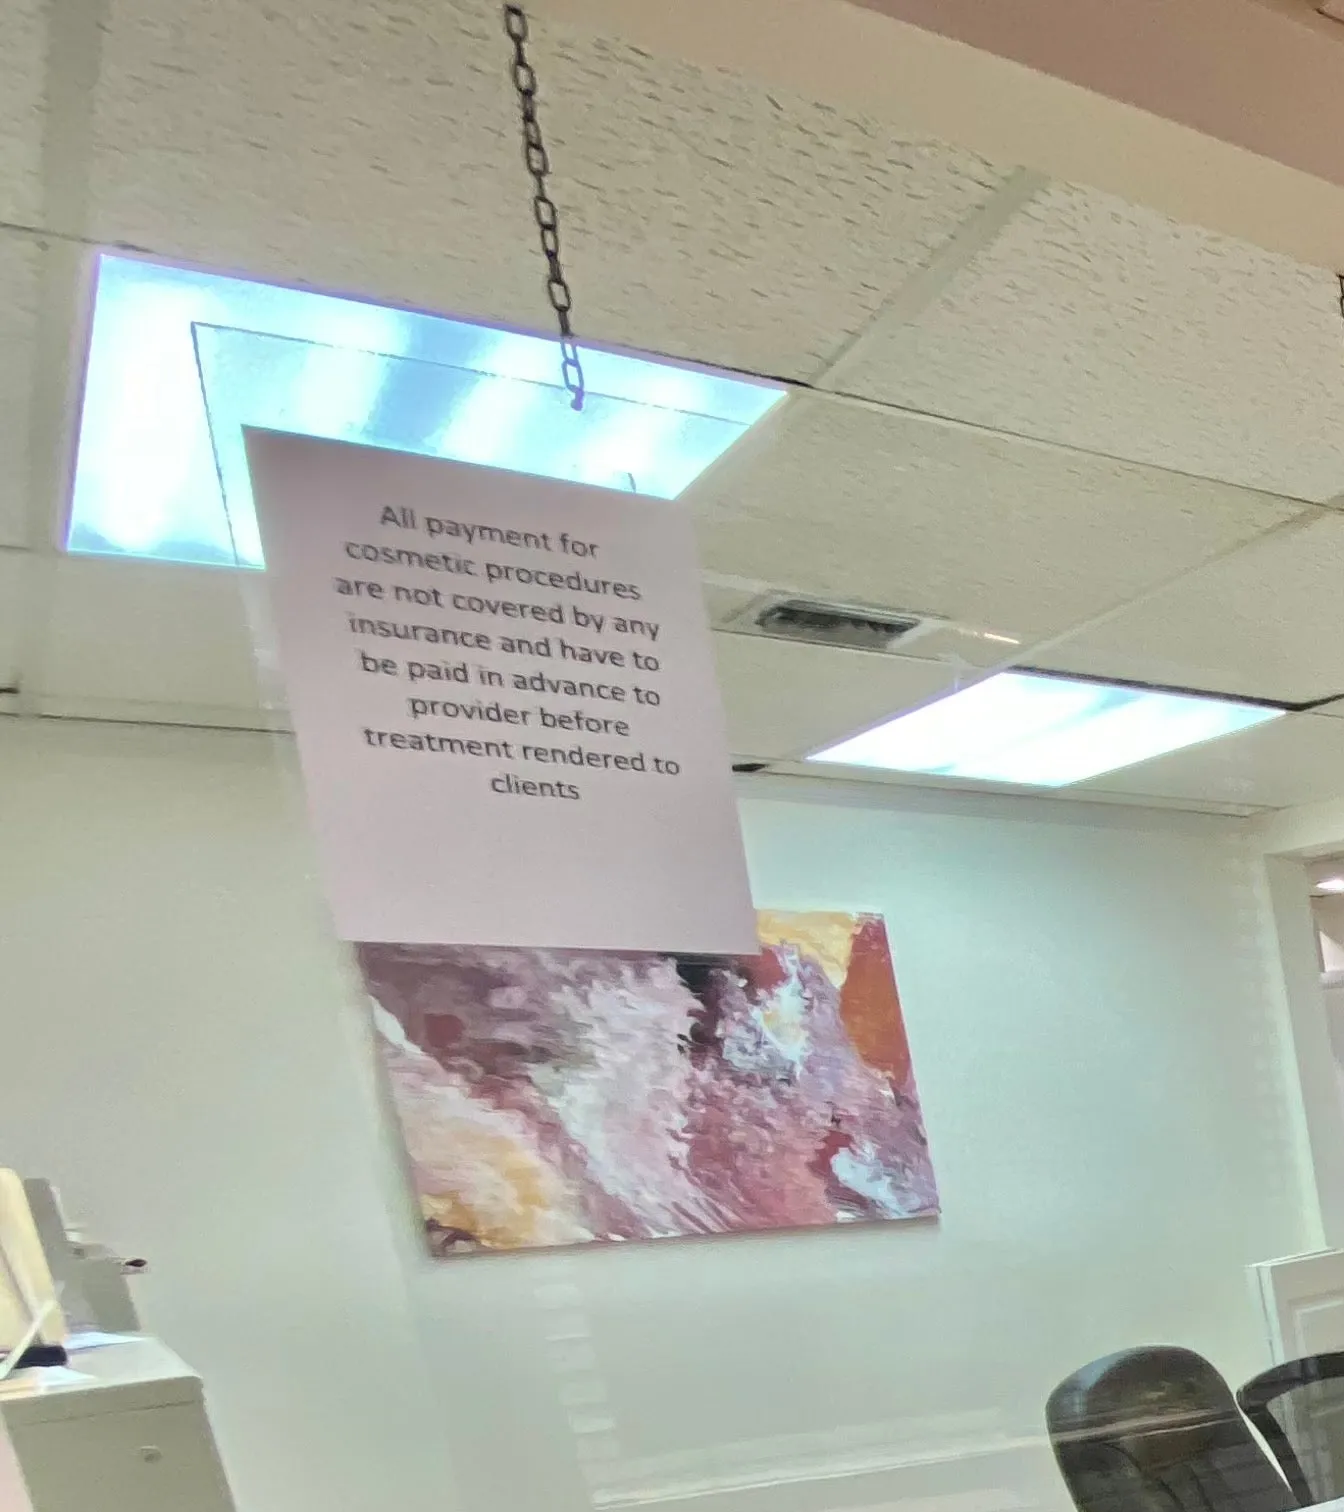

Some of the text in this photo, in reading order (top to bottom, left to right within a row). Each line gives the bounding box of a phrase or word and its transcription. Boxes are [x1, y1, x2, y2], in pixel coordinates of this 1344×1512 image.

[380, 505, 599, 558] All payment for
[345, 541, 642, 602] cosmetic procedures
[335, 576, 661, 642] are not covered by any
[349, 616, 661, 672] insurance and have to
[360, 651, 661, 707] be paid in advance to
[407, 696, 630, 738] provider before
[362, 727, 681, 776] treatment rendered to
[490, 773, 581, 801] clients
